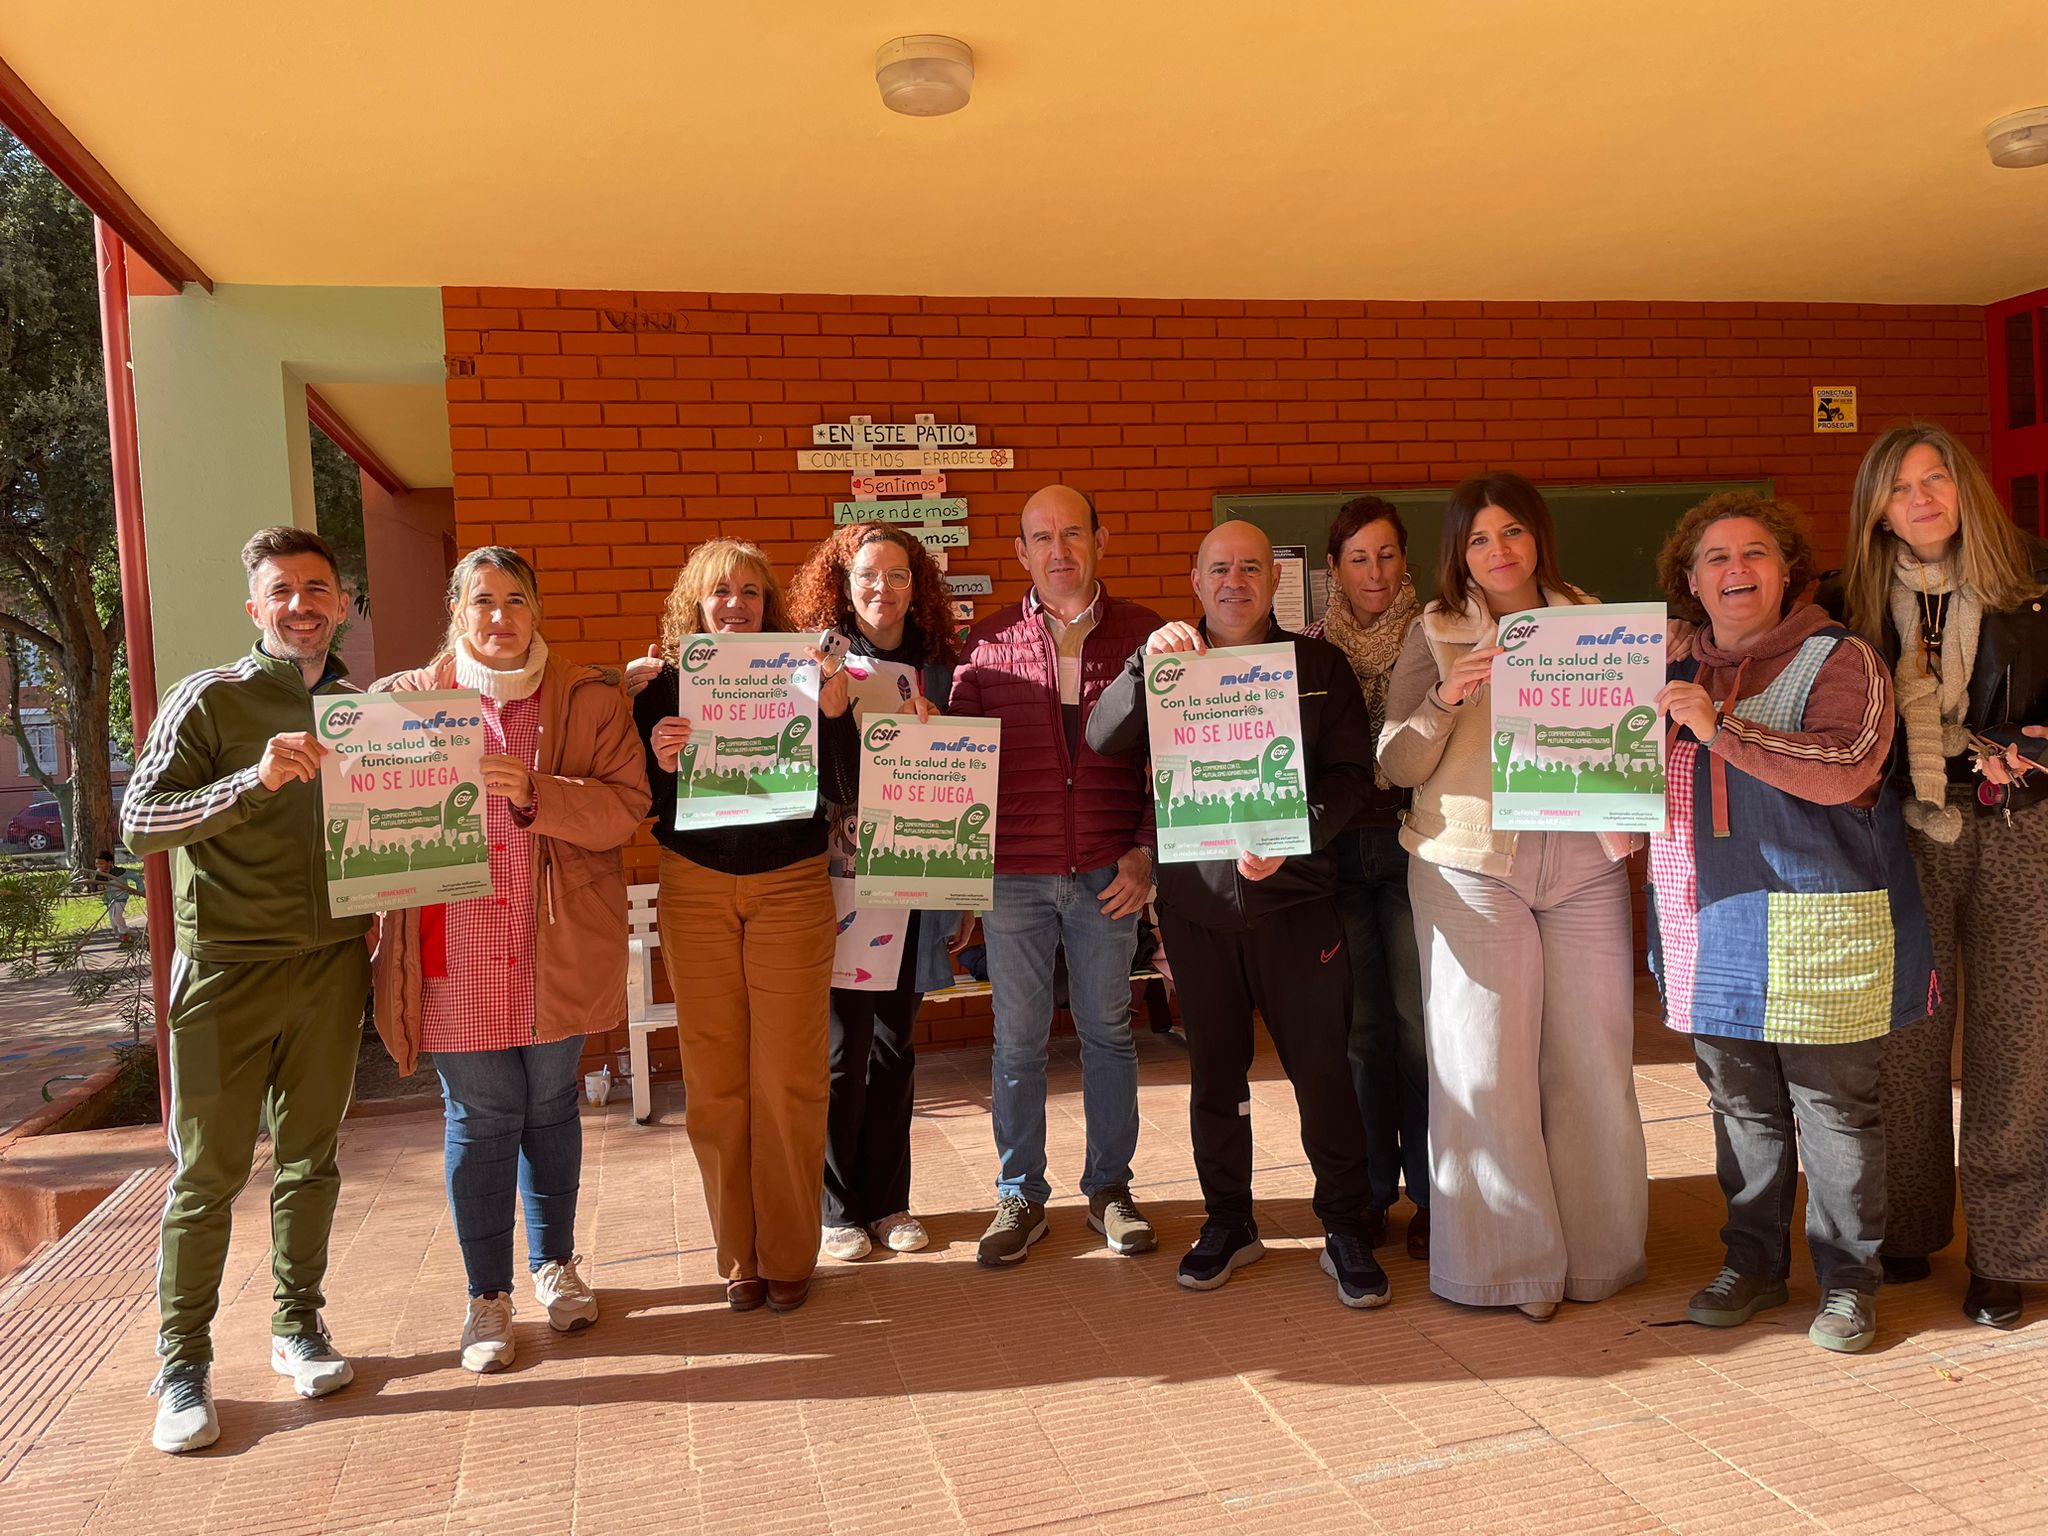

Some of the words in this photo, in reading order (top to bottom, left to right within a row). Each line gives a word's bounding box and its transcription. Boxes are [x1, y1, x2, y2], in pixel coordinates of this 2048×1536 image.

[828, 426, 854, 443] EN
[864, 425, 906, 443] ESTE
[811, 452, 905, 468] COMETEMOS
[923, 451, 984, 466] ERRORES
[839, 501, 959, 522] Aprendemos
[1507, 655, 1534, 666] Con
[1539, 654, 1553, 666] la
[1558, 653, 1598, 666] salud
[1603, 652, 1622, 665] de
[1627, 652, 1650, 665] l@s
[691, 675, 714, 686] Con
[719, 674, 730, 685] la
[735, 674, 768, 686] salud
[771, 674, 787, 685] de
[790, 673, 807, 684] l@s
[1530, 669, 1624, 682] funcionari@s
[712, 688, 788, 699] funcionari@s
[1161, 698, 1185, 709] Con
[1189, 695, 1201, 706] la
[1205, 691, 1241, 705] salud
[1245, 690, 1260, 701] de
[1265, 688, 1284, 700] l@s
[1519, 687, 1543, 707] NO
[1551, 687, 1571, 707] SE
[1579, 687, 1634, 707] JUEGA
[702, 703, 723, 721] NO
[729, 703, 747, 720] SE
[752, 702, 795, 720] JUEGA
[1183, 705, 1263, 721] funcionari@s
[1174, 727, 1196, 745] NO
[1202, 724, 1221, 743] SE
[1227, 719, 1275, 741] JUEGA
[335, 743, 363, 754] Con
[368, 740, 381, 751] la
[386, 737, 425, 750] salud
[429, 736, 446, 748] de
[450, 735, 470, 746] l@s
[361, 751, 448, 767] funcionari@s
[873, 755, 896, 766] Con
[900, 756, 911, 766] la
[915, 757, 947, 768] salud
[951, 758, 966, 768] de
[969, 758, 986, 770] l@s
[351, 773, 375, 793] NO
[383, 771, 402, 790] SE
[409, 766, 459, 788] JUEGA
[892, 769, 966, 782] funcionari@s
[882, 784, 903, 800] NO
[908, 785, 925, 802] SE
[930, 786, 974, 803] JUEGA
